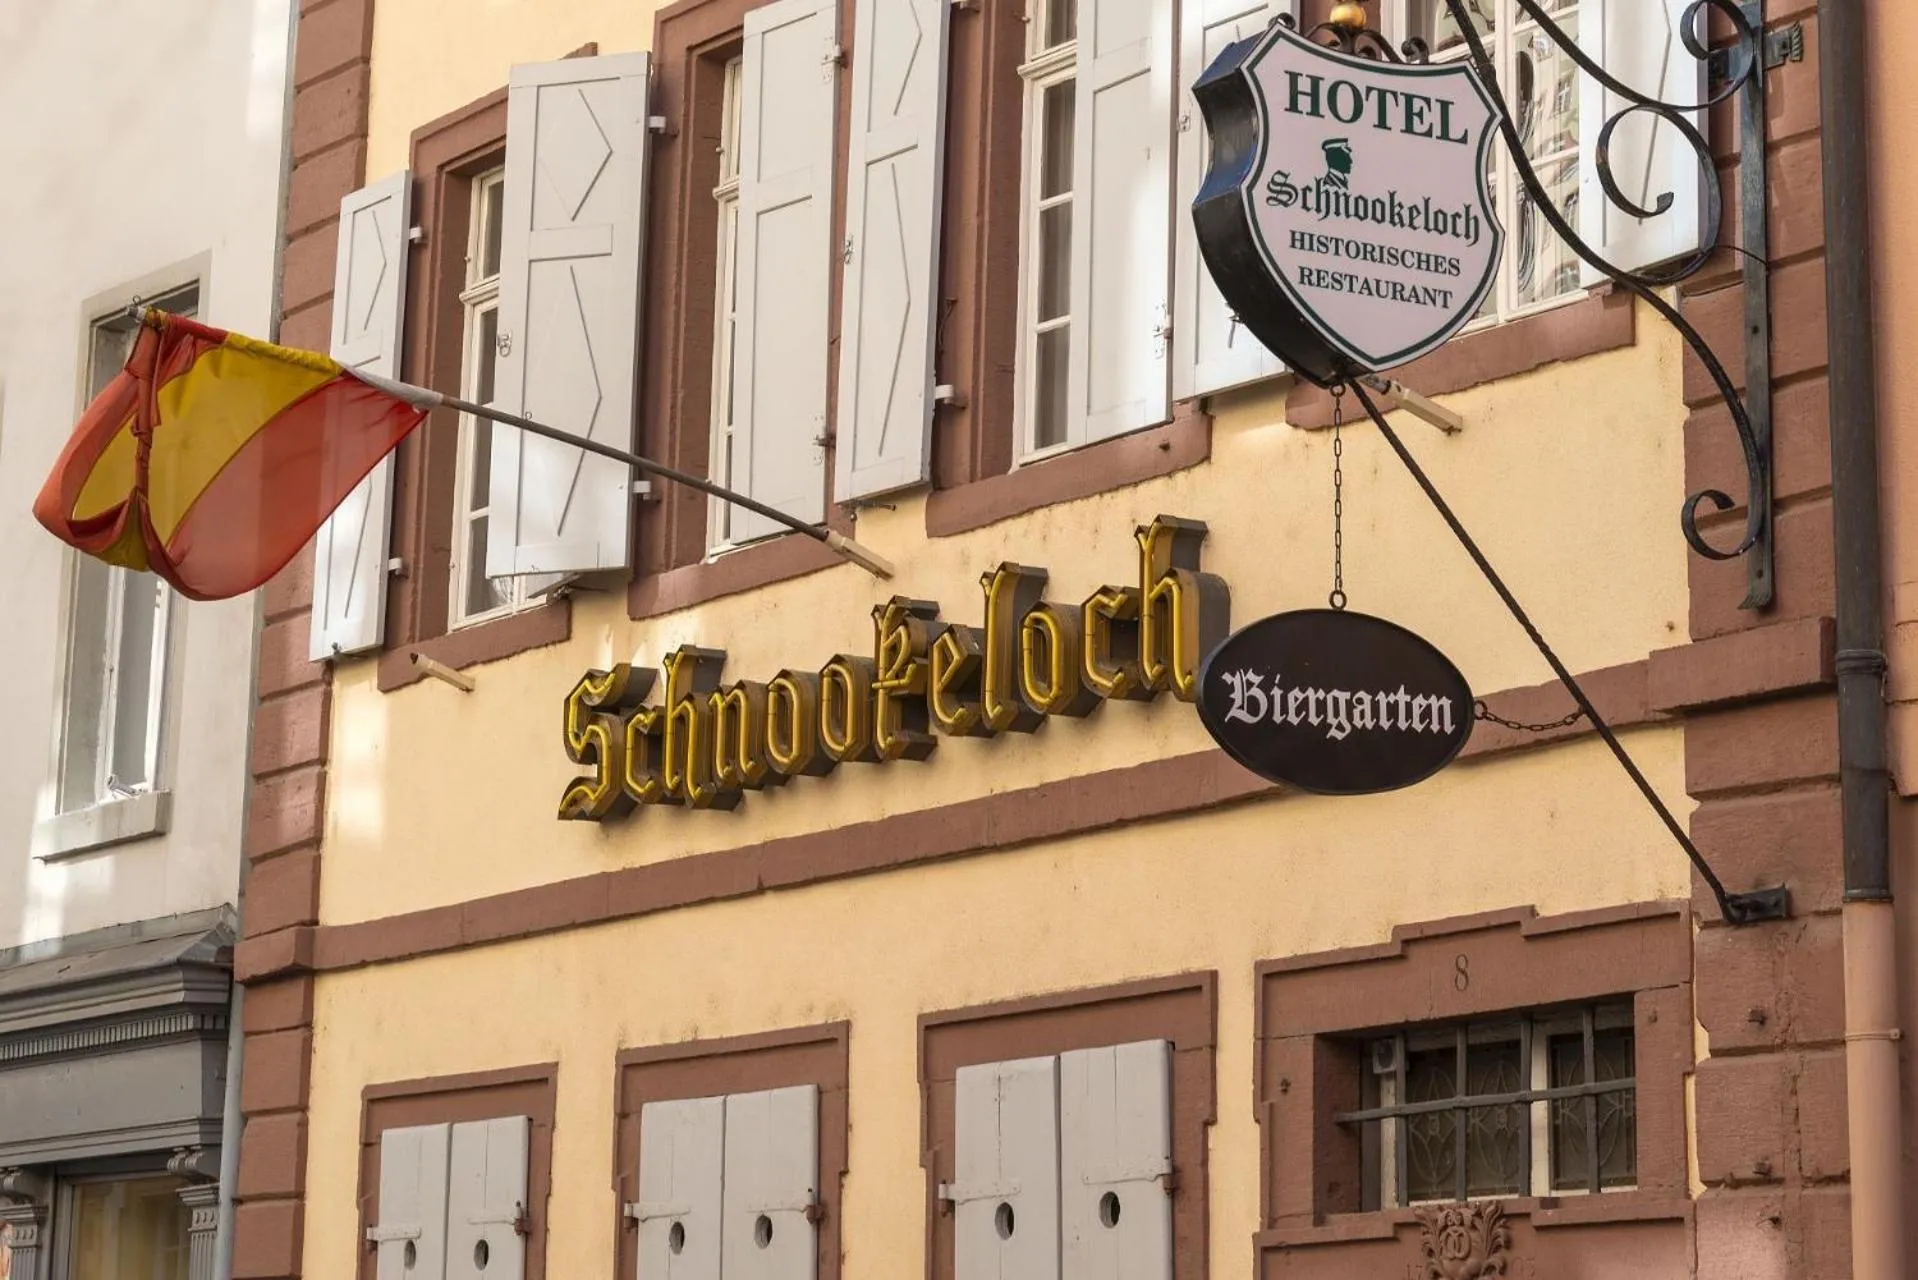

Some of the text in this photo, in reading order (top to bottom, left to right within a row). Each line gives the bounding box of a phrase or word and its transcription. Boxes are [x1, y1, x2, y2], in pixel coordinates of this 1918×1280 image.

[1284, 70, 1469, 145] HOTEL
[1266, 170, 1480, 247] Schnookeloch
[1289, 229, 1461, 277] HISTORISCHES
[1298, 266, 1453, 309] RESTAURANT
[558, 514, 1230, 821] Schnookeloch
[1221, 668, 1456, 741] Biergarten
[1455, 953, 1469, 992] 8
